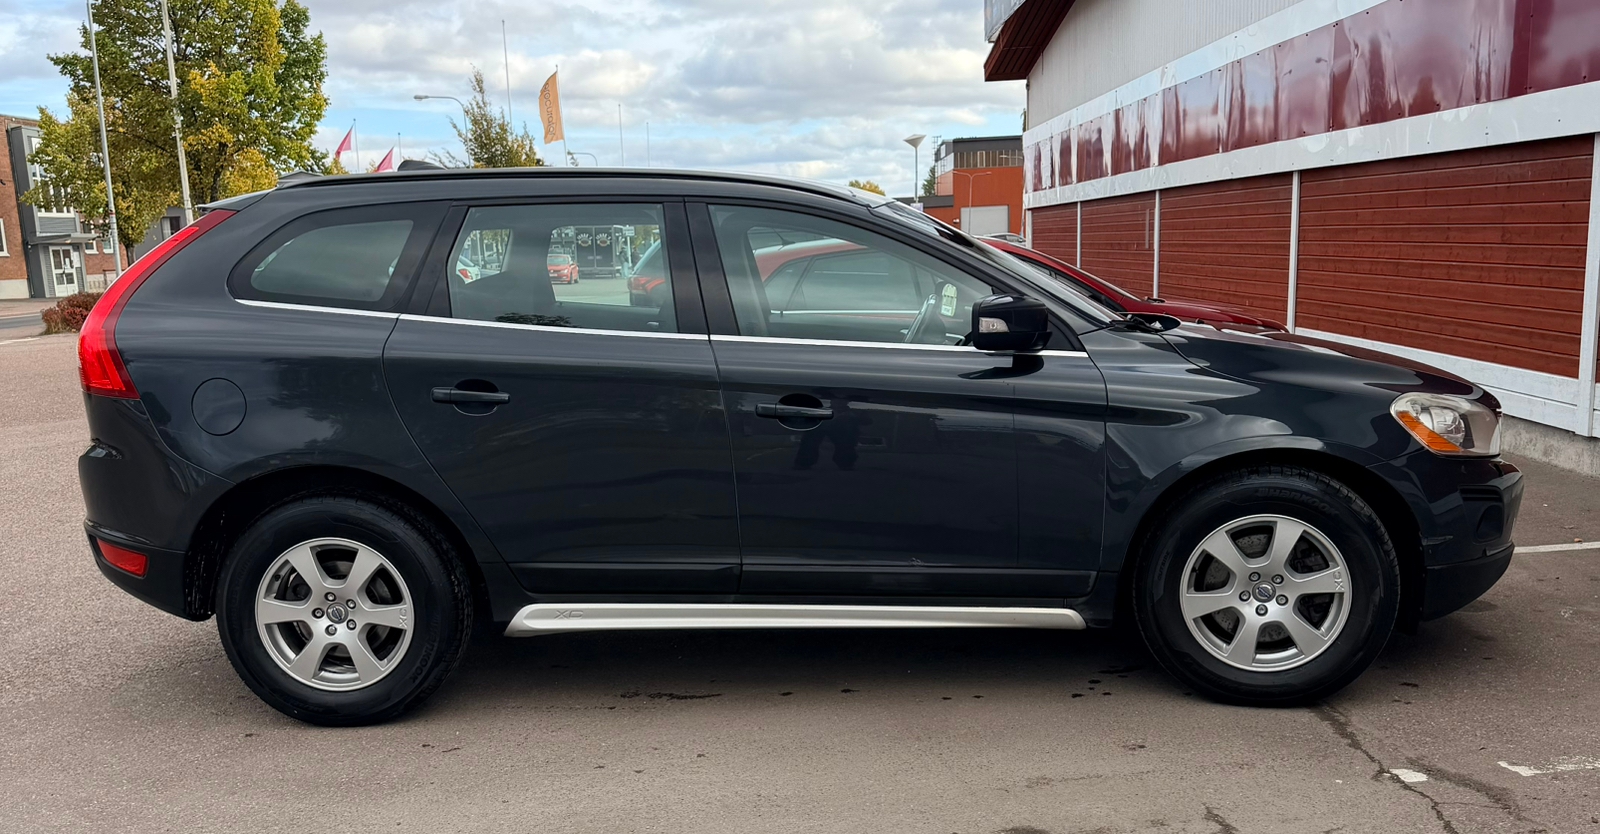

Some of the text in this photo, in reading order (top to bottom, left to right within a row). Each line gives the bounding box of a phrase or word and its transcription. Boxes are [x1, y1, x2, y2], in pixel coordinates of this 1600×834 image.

[543, 82, 556, 136] procurator
[1332, 570, 1345, 591] XC
[399, 608, 408, 628] XC
[554, 609, 583, 620] XC
